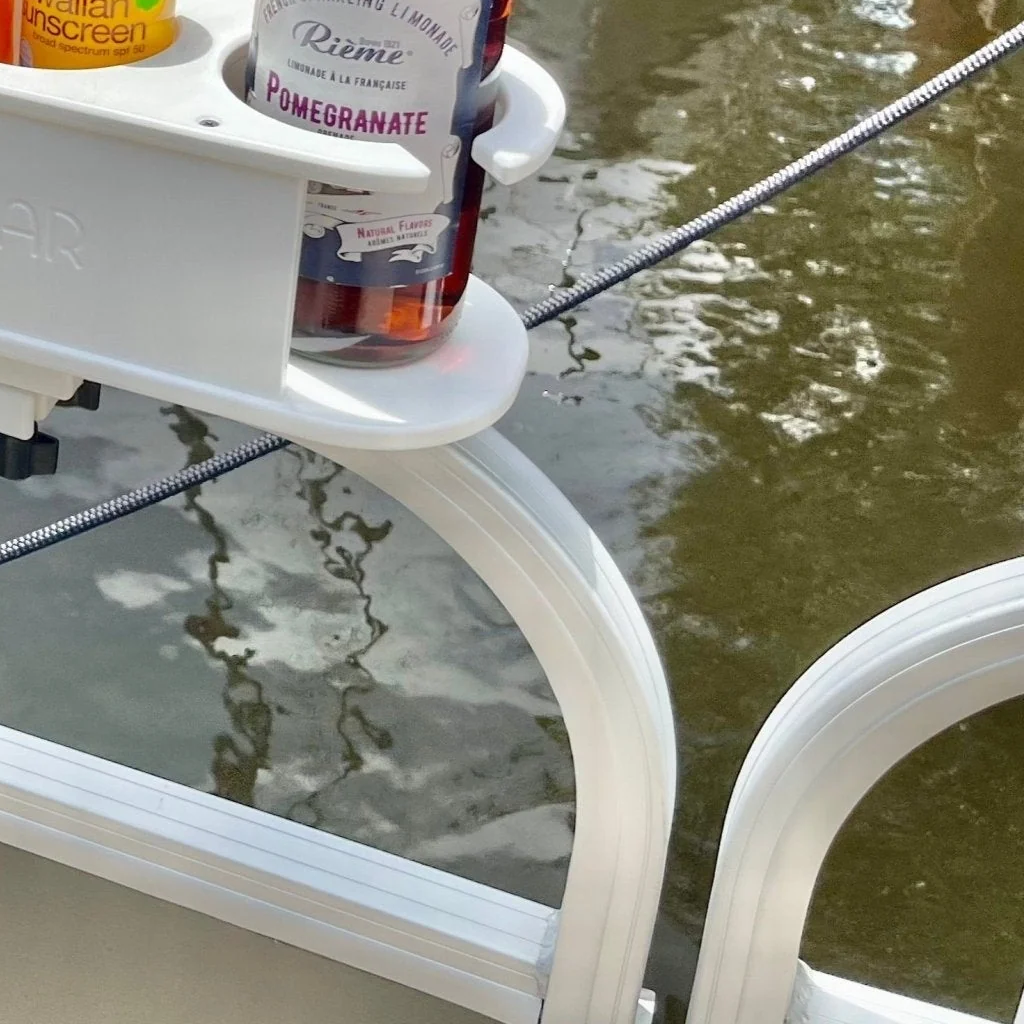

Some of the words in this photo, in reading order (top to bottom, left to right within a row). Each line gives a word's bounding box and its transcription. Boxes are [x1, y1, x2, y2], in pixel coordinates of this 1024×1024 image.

[23, 0, 146, 45] unscreen
[292, 20, 406, 65] Rième
[390, 2, 458, 57] LIMONADE
[58, 41, 110, 57] spectrum
[287, 58, 327, 80] LIMONADE
[339, 74, 351, 85] LA
[355, 76, 406, 91] FRANÇAISE
[266, 69, 428, 135] POMEGRANATE
[357, 225, 395, 238] NATURAL
[399, 219, 433, 231] FLAVORS
